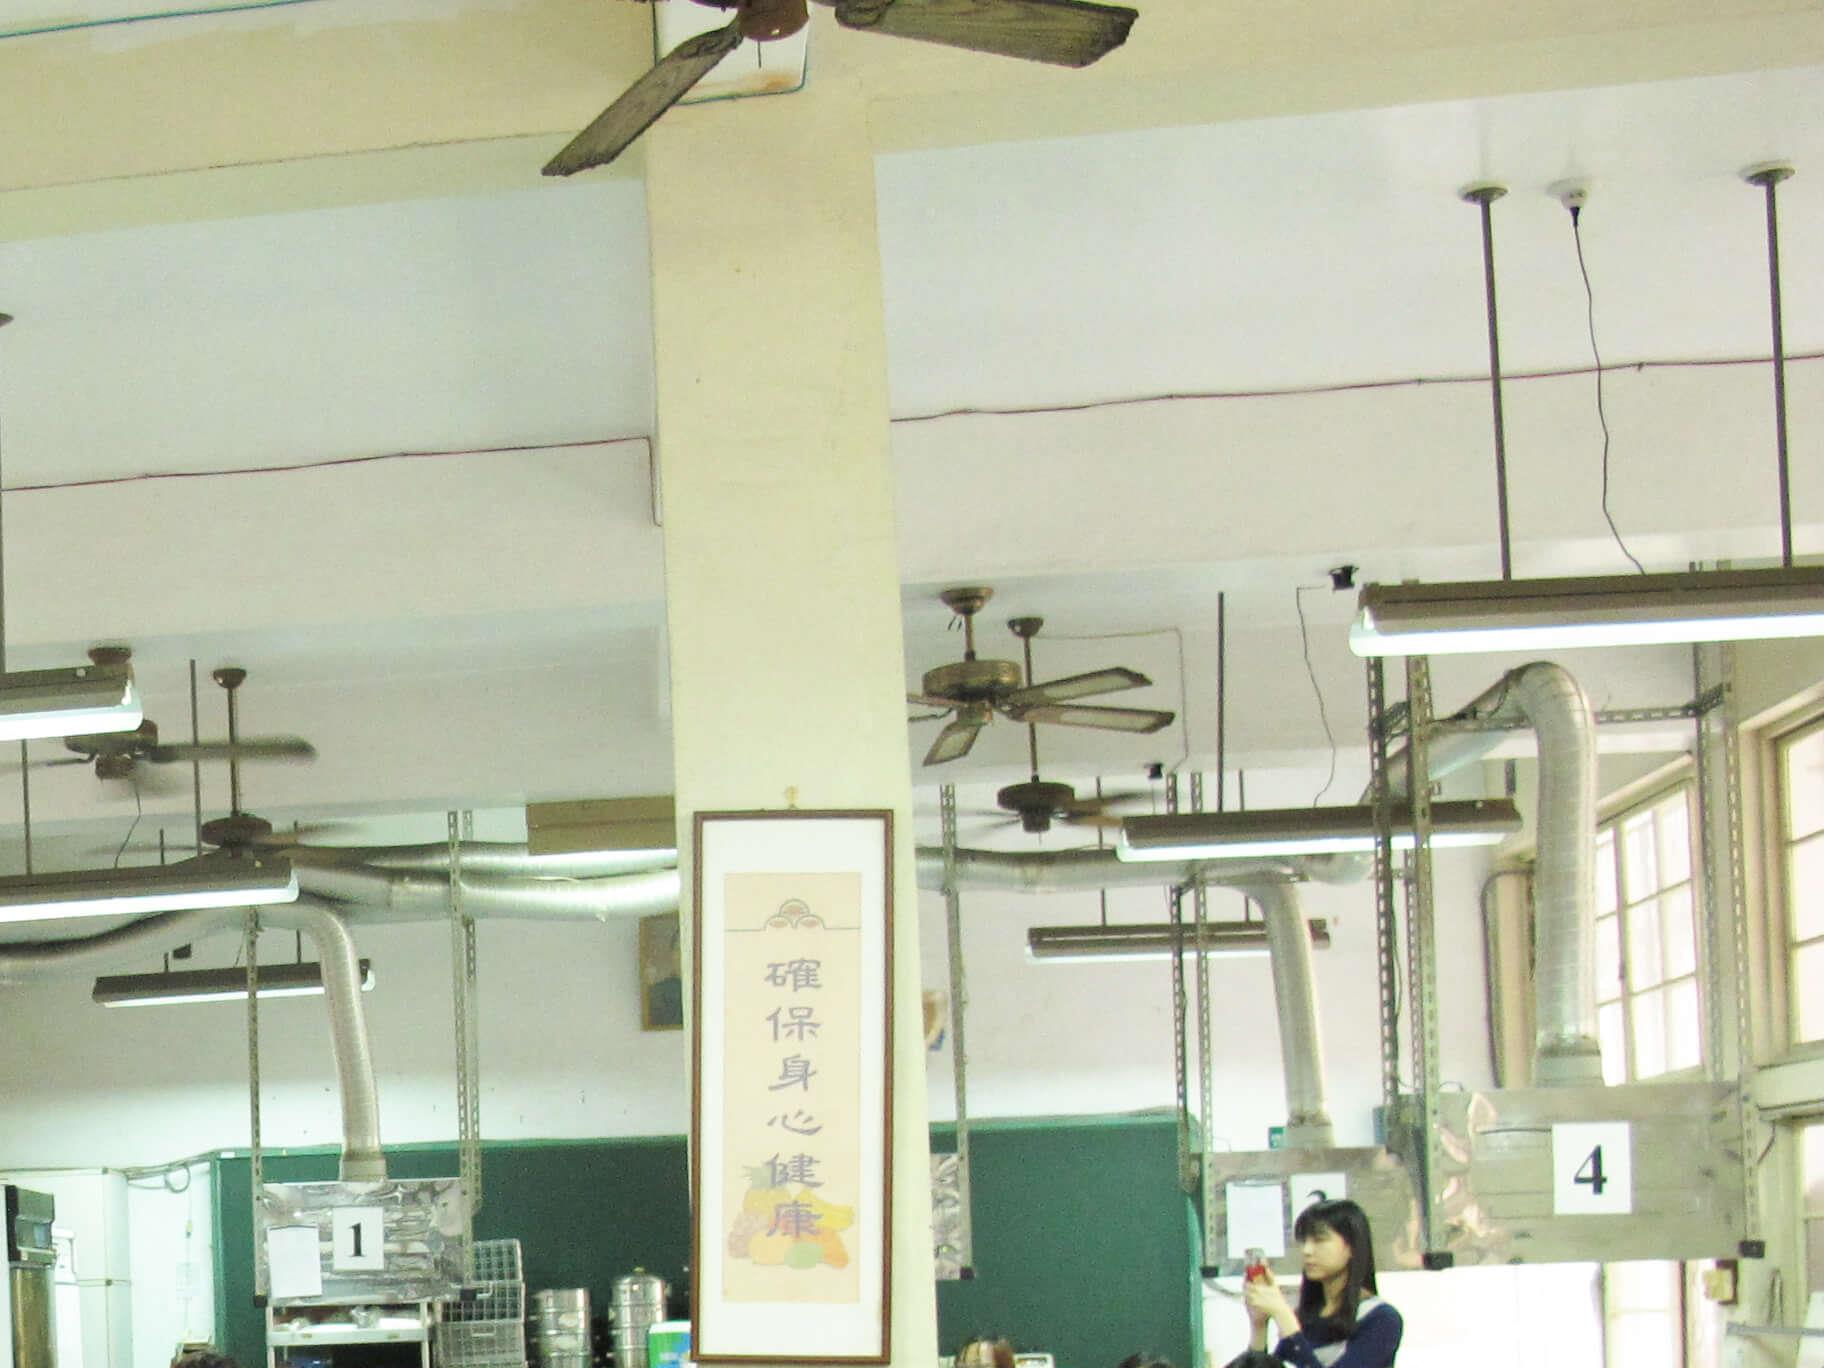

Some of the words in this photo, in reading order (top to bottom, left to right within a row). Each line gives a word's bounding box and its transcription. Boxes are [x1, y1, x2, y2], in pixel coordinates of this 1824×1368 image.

[764, 957, 824, 1239] 確保身心健康
[1573, 1144, 1607, 1196] 4
[349, 1222, 366, 1258] 1
